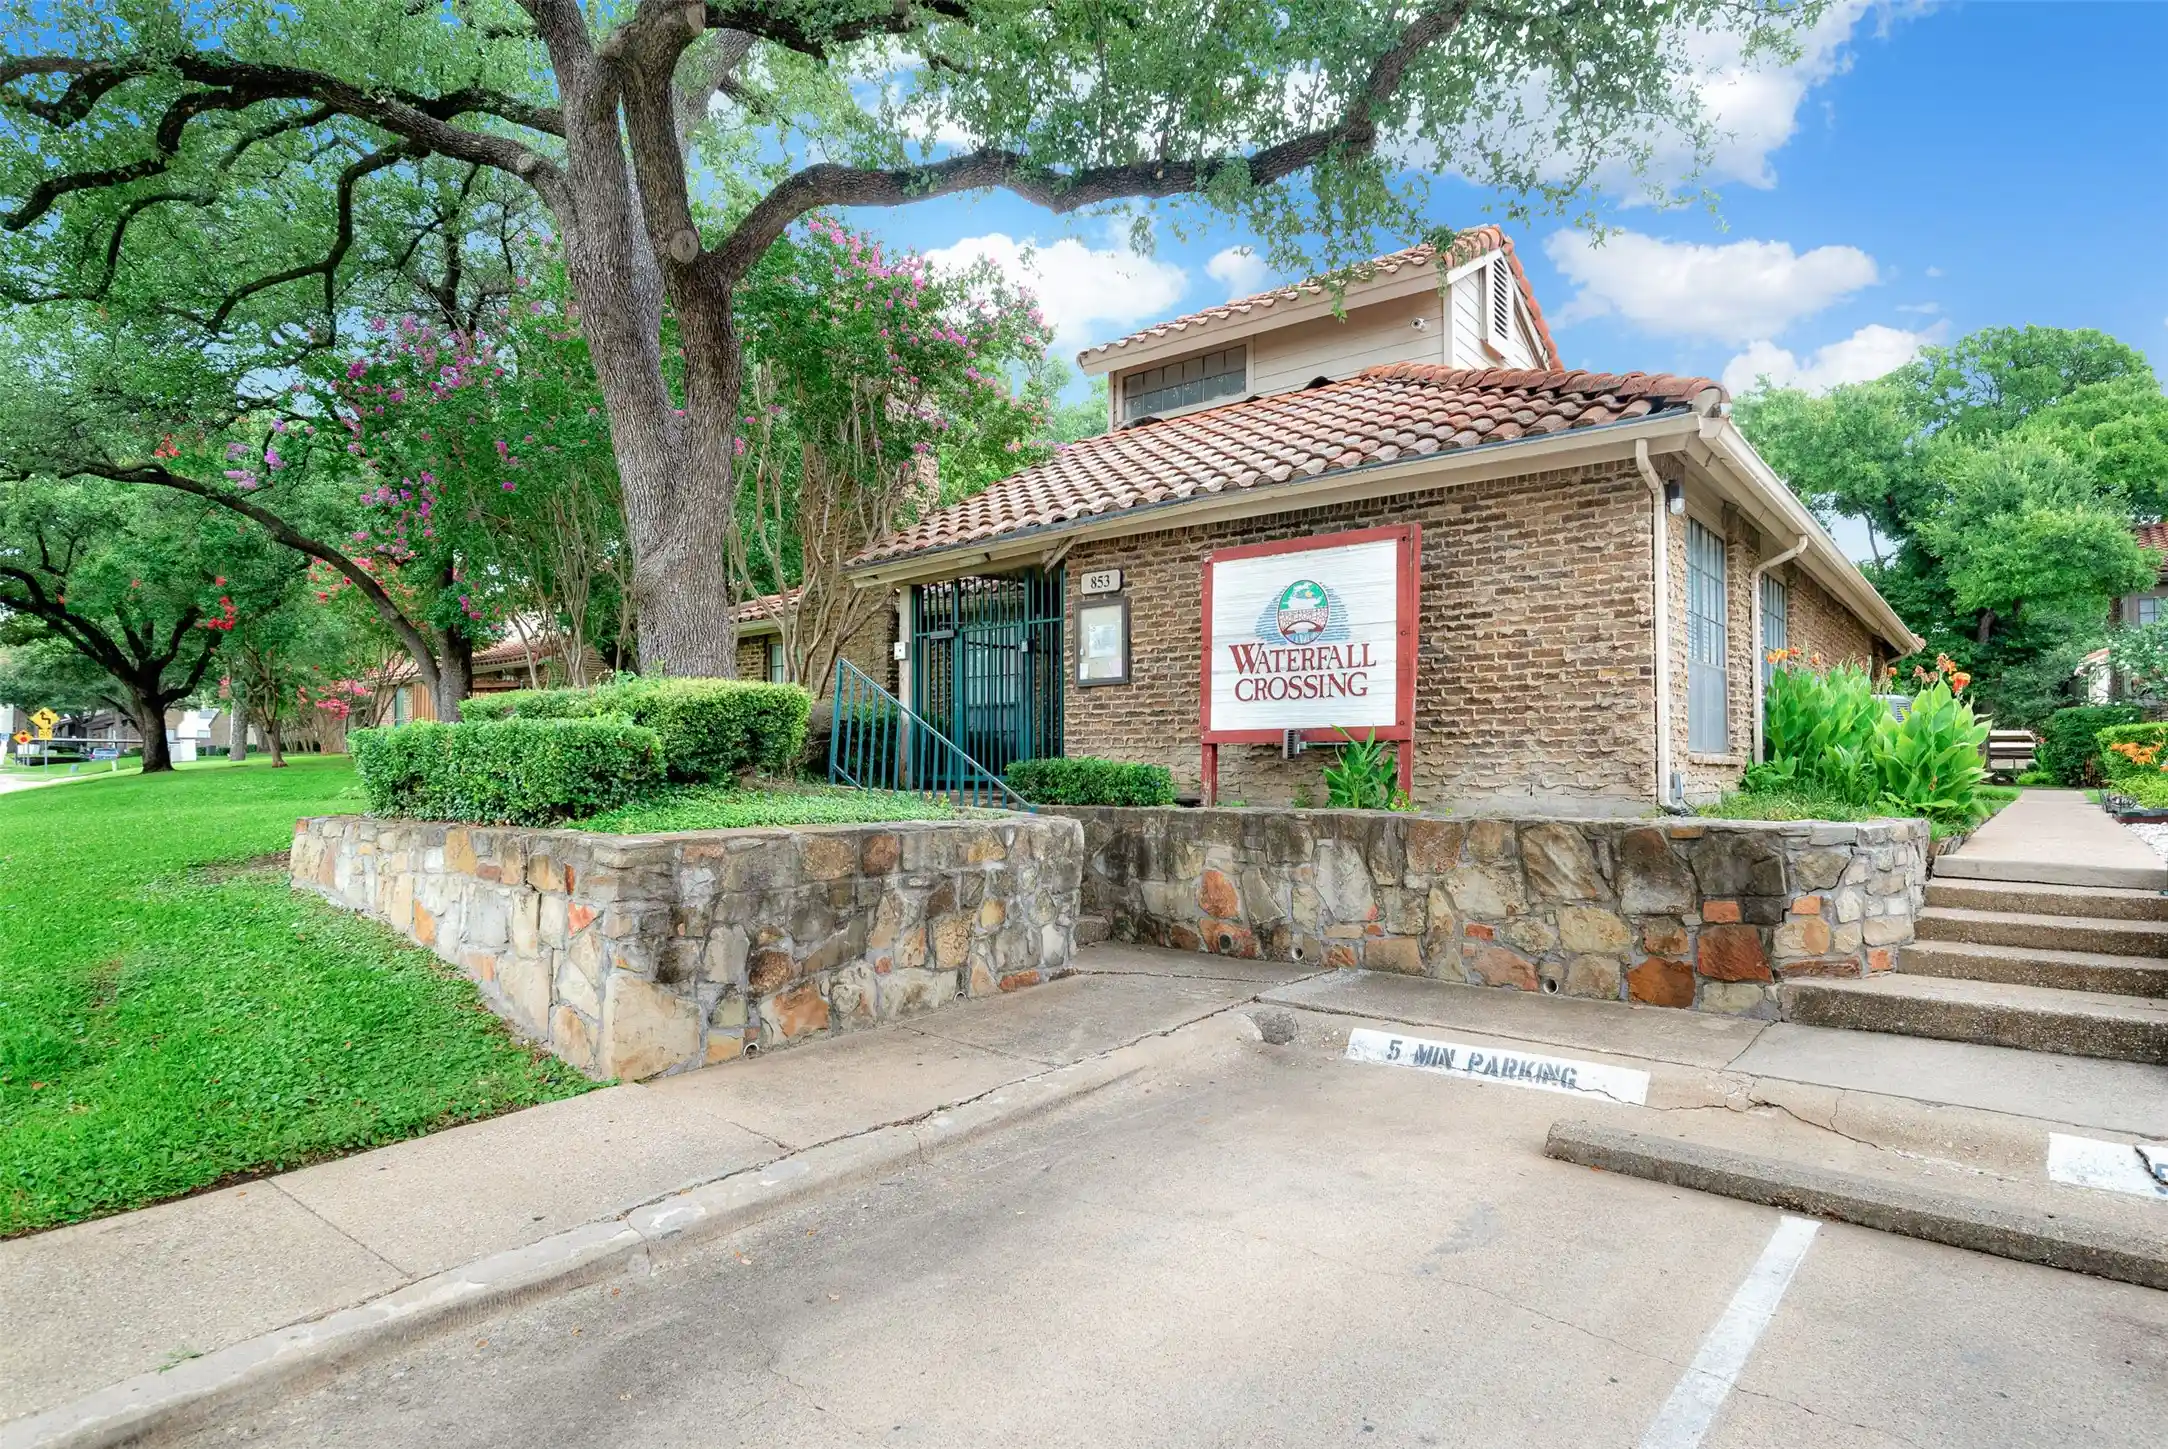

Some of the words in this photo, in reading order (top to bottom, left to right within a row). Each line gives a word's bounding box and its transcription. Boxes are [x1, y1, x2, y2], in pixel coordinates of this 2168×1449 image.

[1091, 575, 1110, 589] 853
[1229, 643, 1376, 675] WATERFALL
[1235, 672, 1368, 702] CROSSING
[1387, 1039, 1403, 1061] 5
[1413, 1043, 1456, 1070] MIN
[1467, 1051, 1578, 1090] PARKING
